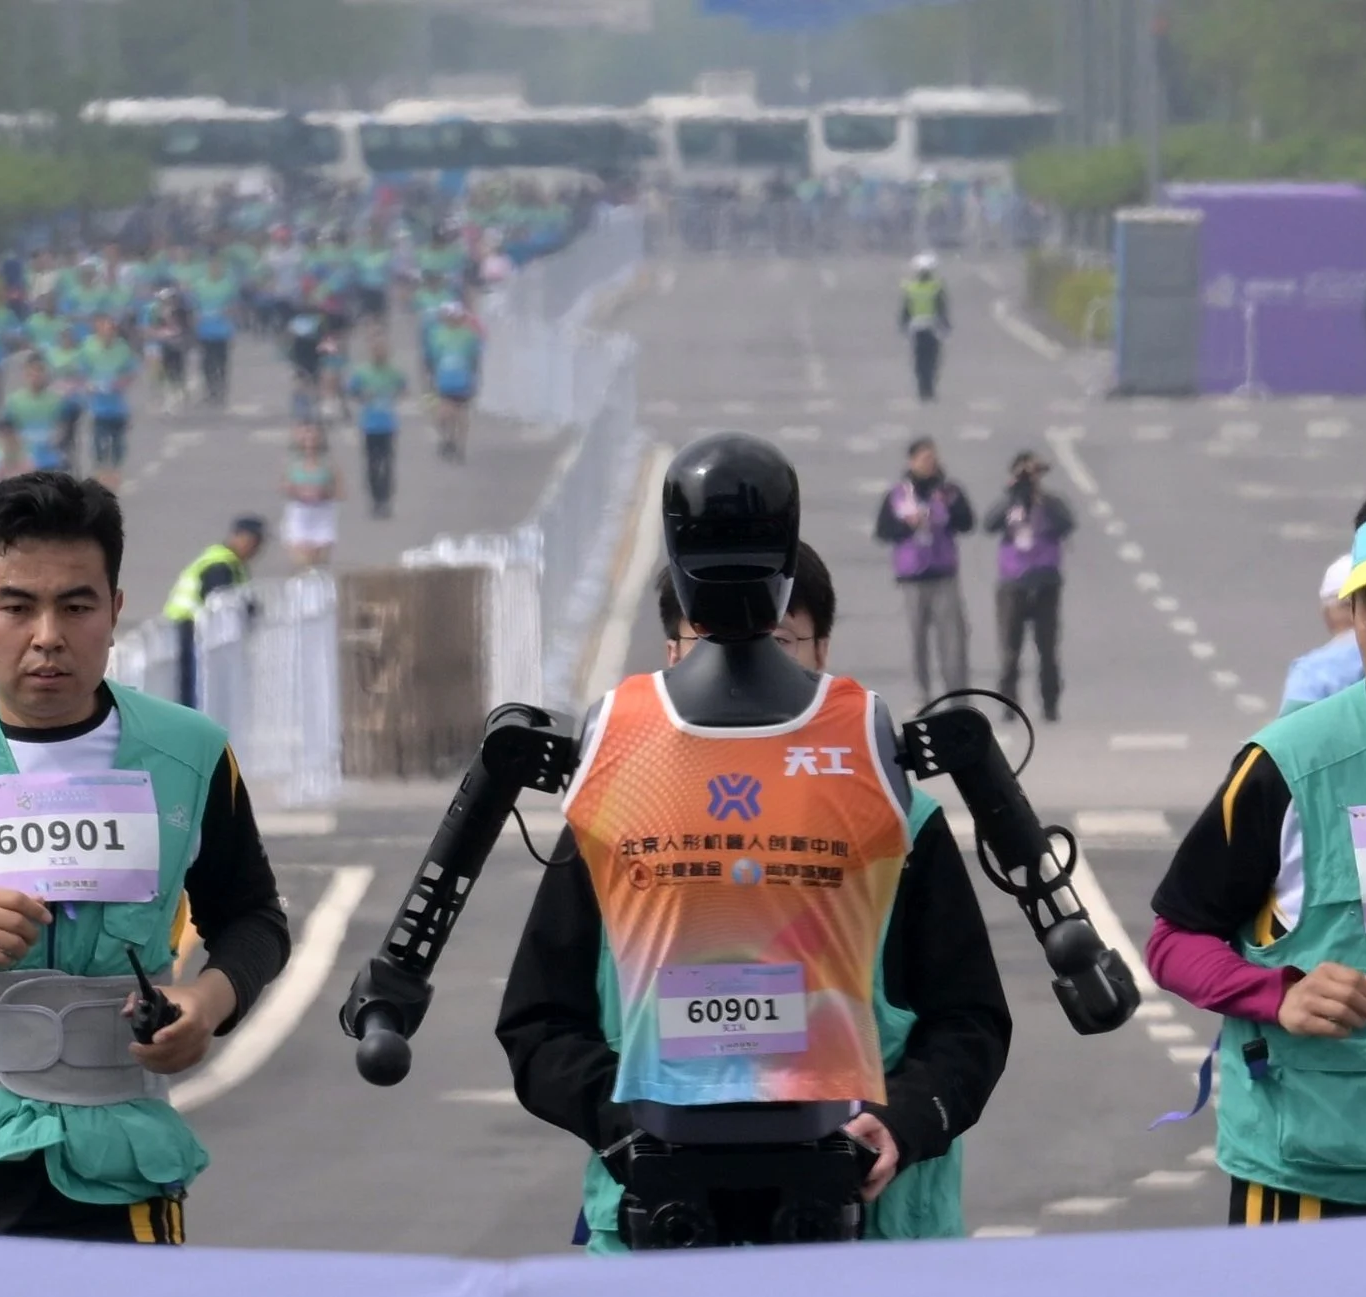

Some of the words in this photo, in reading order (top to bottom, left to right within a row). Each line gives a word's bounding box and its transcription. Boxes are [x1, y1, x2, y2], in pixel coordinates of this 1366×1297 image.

[783, 746, 855, 777] 天工
[620, 833, 849, 858] 北京人形机器人创新中心
[688, 997, 780, 1023] 60901
